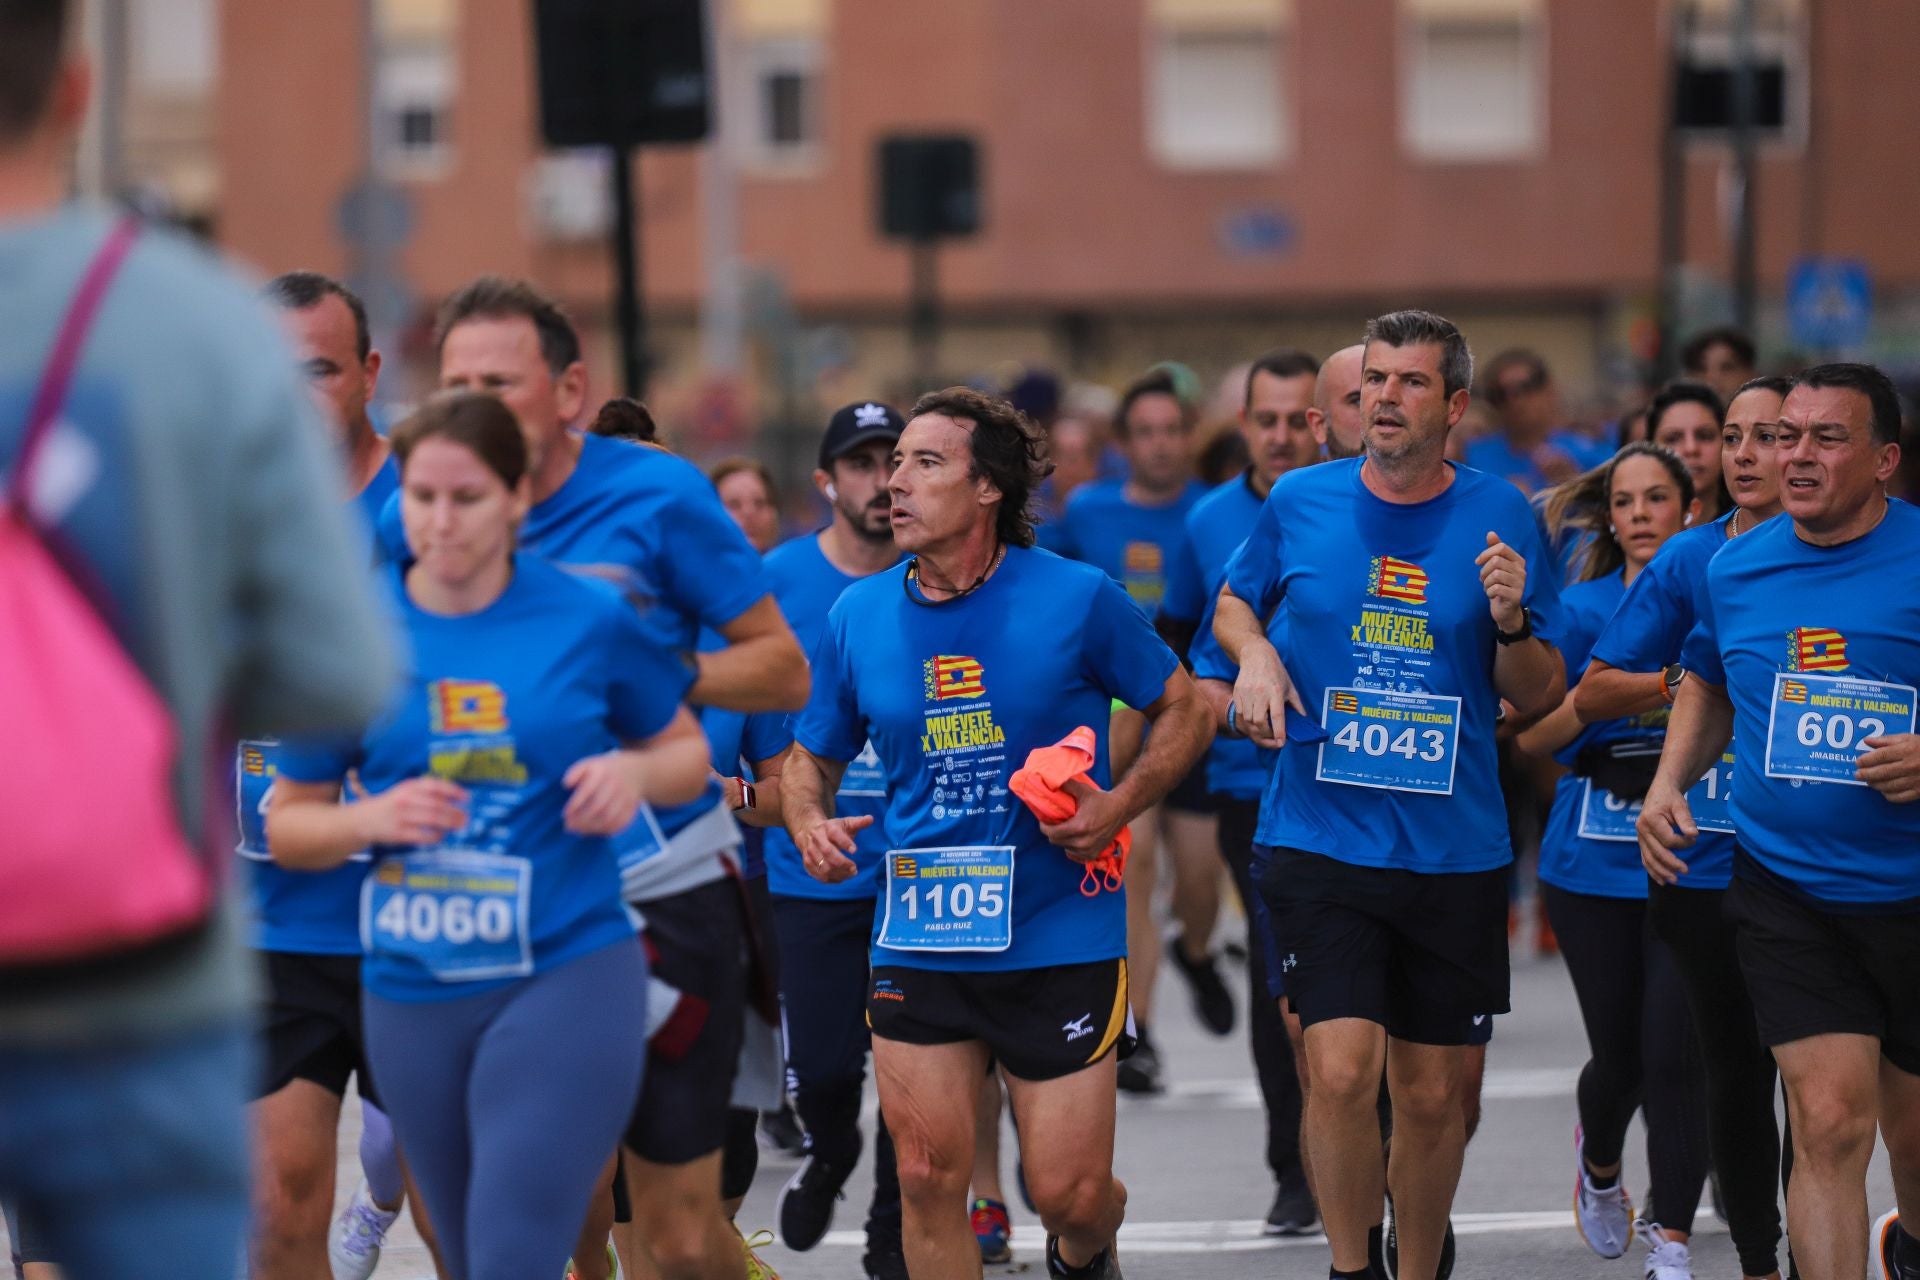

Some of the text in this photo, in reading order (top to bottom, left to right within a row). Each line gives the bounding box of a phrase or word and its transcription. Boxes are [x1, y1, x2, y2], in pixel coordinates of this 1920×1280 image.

[1361, 611, 1428, 634] MUÉVETE
[1351, 625, 1434, 650] X VALENCIA
[1362, 706, 1452, 724] MUÉVETE X VALENCIA
[1811, 694, 1908, 715] MUÉVETE X VALENCIA
[926, 710, 993, 734] MUÉVETE
[1797, 712, 1885, 752] 602
[921, 726, 1005, 752] X VALENCIA
[1334, 720, 1445, 761] 4043
[921, 865, 1009, 878] MUÉVETE X VALENCIA
[901, 883, 1003, 919] 1105
[376, 892, 513, 944] 4060
[925, 923, 950, 931] PABLO
